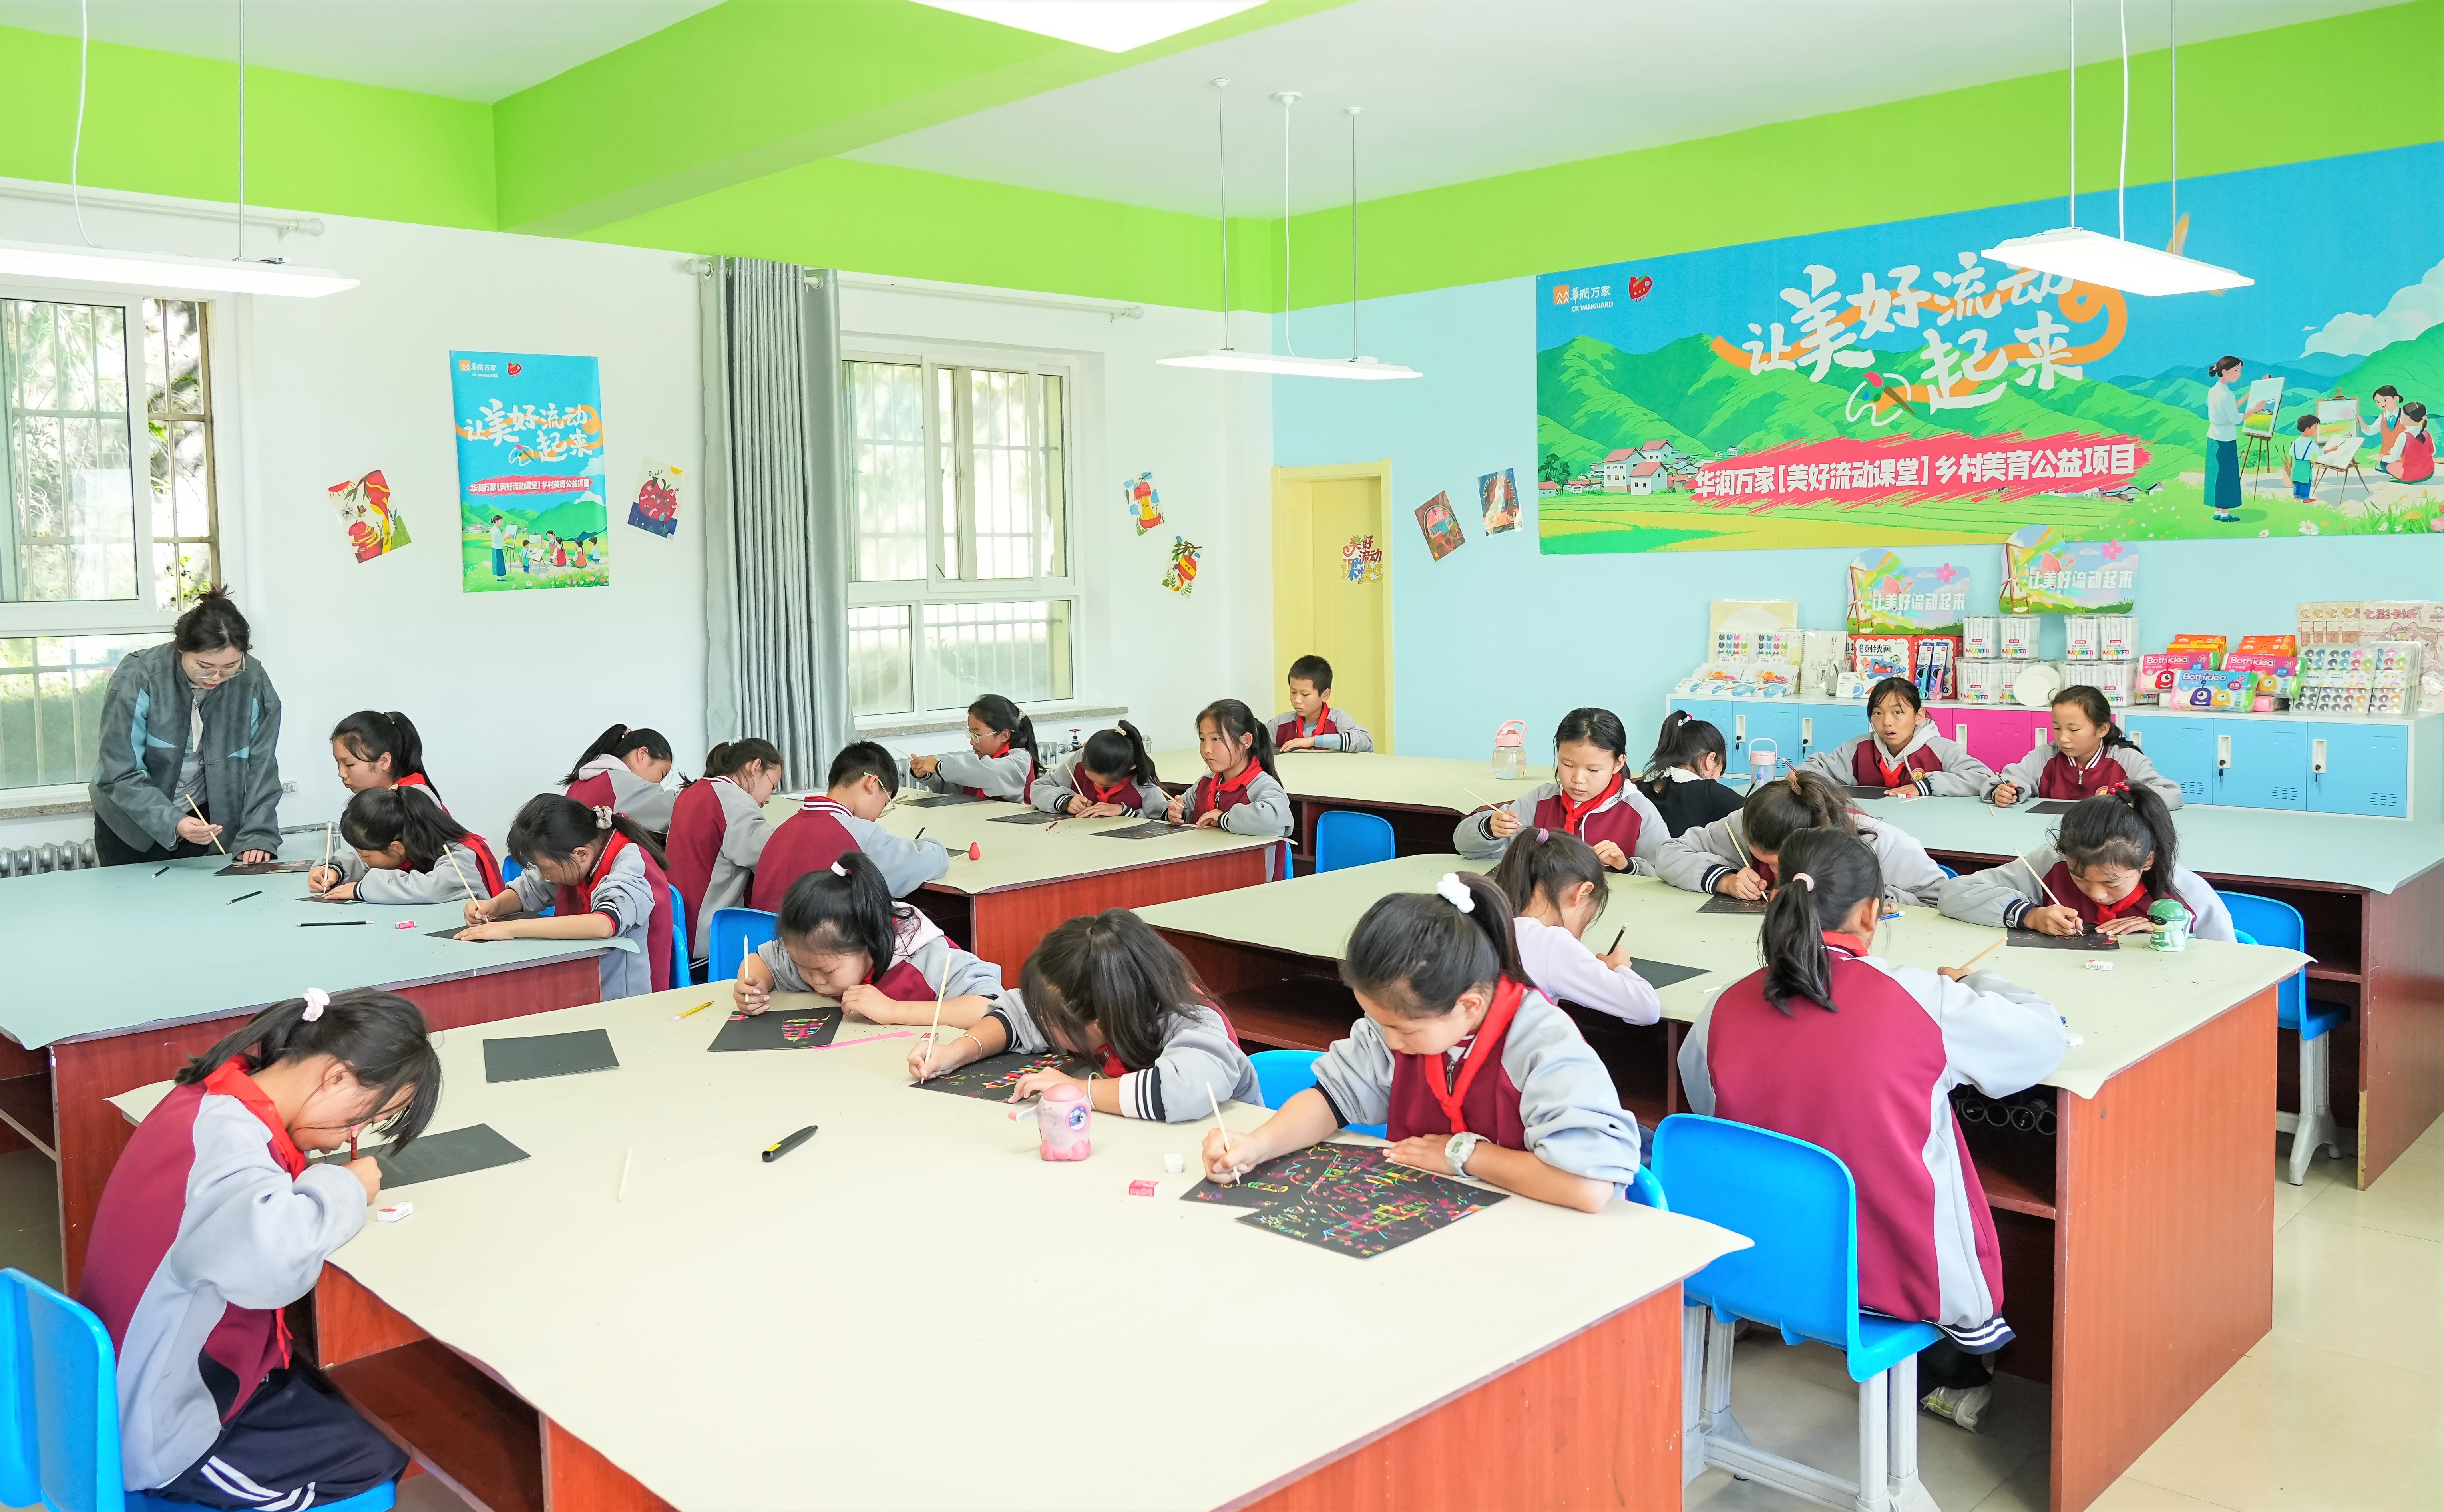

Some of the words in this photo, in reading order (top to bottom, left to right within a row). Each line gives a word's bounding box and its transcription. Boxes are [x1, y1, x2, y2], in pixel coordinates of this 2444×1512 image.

[1580, 301, 1613, 310] VANGUARD
[1921, 311, 2083, 415] 起来
[463, 398, 587, 446] 让美好流动
[535, 428, 592, 463] 起来
[2028, 570, 2133, 589] 让美好流动起来
[1872, 592, 1966, 611] 让美好流动起来
[2364, 608, 2417, 619] 七彩卡纸
[1865, 644, 1892, 653] 刺绣画
